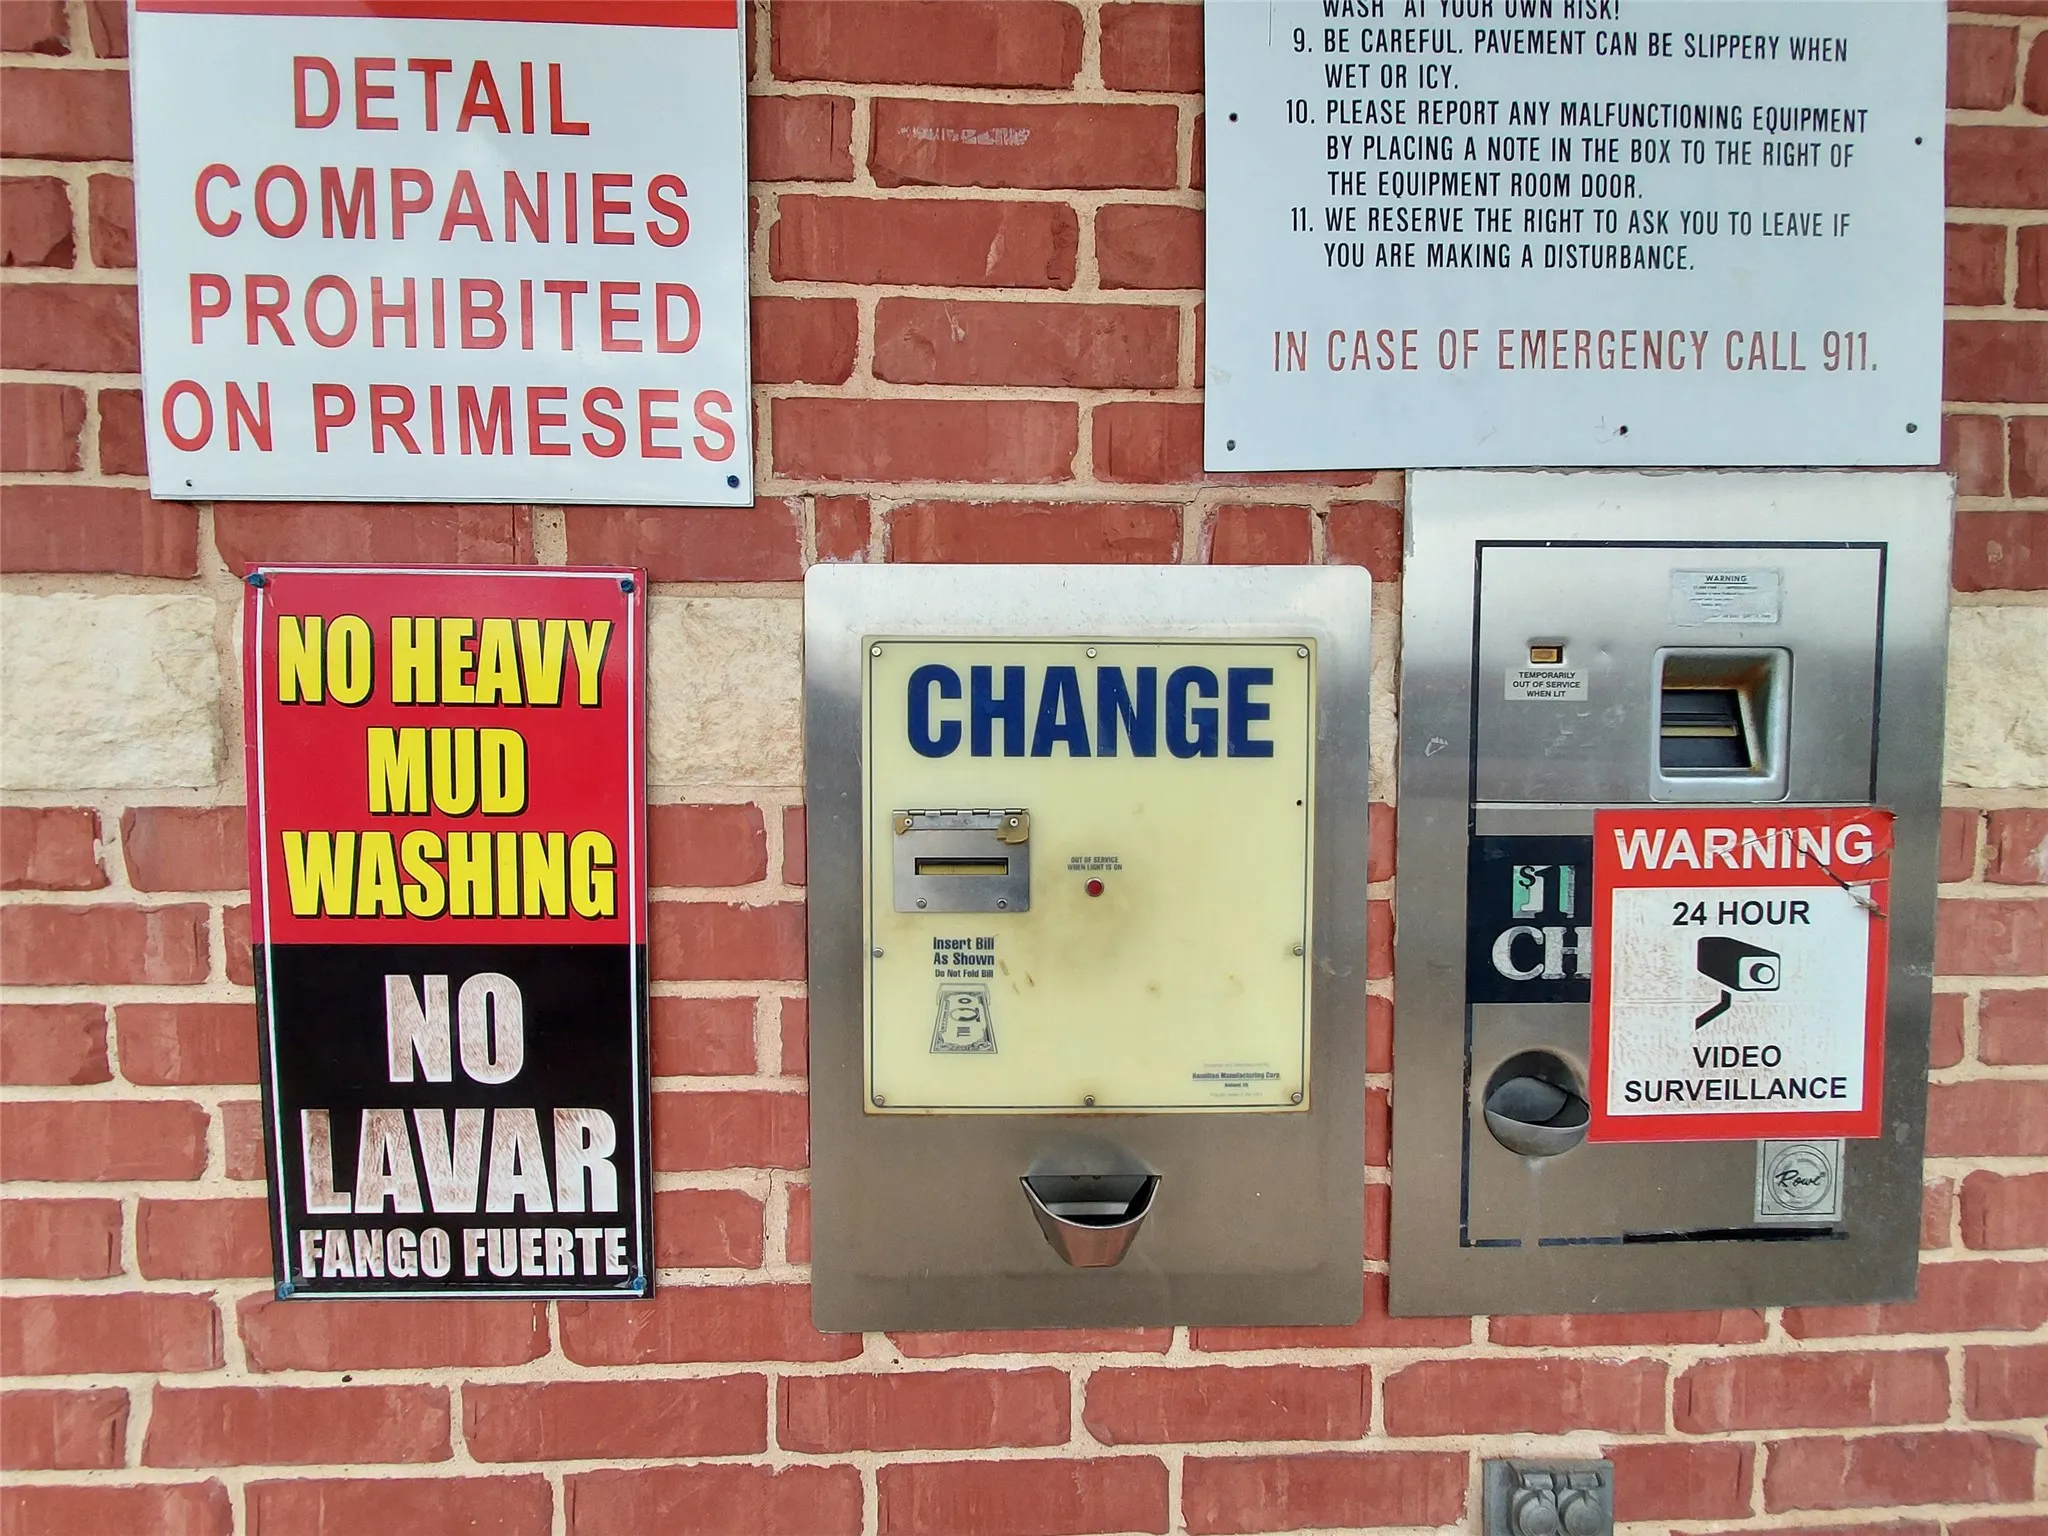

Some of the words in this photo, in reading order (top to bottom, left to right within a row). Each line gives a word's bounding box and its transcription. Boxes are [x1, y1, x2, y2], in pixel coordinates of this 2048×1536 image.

[1322, 0, 1384, 18] WASH
[1404, 0, 1425, 18] AT
[1440, 0, 1493, 18] YOUR
[1505, 0, 1552, 19] OWN
[1564, 0, 1619, 21] RISK!
[1293, 27, 1312, 53] 9.
[1324, 28, 1350, 53] BE
[1361, 28, 1463, 54] CAREFUL.
[1474, 29, 1587, 55] PAVEMENT
[1596, 30, 1637, 56] CAN
[1648, 32, 1673, 57] BE
[1684, 32, 1780, 60] SLIPPERY
[1789, 36, 1847, 62] WHEN
[1324, 63, 1371, 89] WET
[1380, 63, 1407, 89] OR
[1419, 63, 1458, 90] ICY.
[293, 56, 590, 136] DETAIL
[1286, 99, 1315, 124] 10.
[1327, 99, 1407, 125] PLEASE
[1418, 99, 1500, 125] REPORT
[1508, 100, 1550, 126] ANY
[1560, 101, 1742, 130] MALFUNCTIONING
[1753, 106, 1868, 135] EQUIPMENT
[1327, 135, 1353, 160] BY
[1363, 135, 1453, 161] PLACING
[1463, 136, 1477, 161] A
[1487, 136, 1540, 162] NOTE
[1551, 137, 1572, 162] IN
[1581, 137, 1619, 163] THE
[1630, 138, 1671, 164] BOX
[1680, 139, 1705, 165] TO
[1714, 140, 1752, 166] THE
[1763, 141, 1822, 167] RIGHT
[1830, 143, 1854, 168] OF
[1327, 170, 1367, 196] THE
[1378, 170, 1501, 199] EQUIPMENT
[1510, 172, 1570, 198] ROOM
[1581, 173, 1643, 199] DOOR.
[193, 162, 690, 247] COMPANIES
[1291, 206, 1314, 232] 11.
[1324, 206, 1357, 232] WE
[1368, 206, 1464, 233] RESERVE
[1474, 207, 1513, 233] THE
[1524, 208, 1585, 234] RIGHT
[1592, 209, 1617, 234] TO
[1628, 209, 1669, 235] ASK
[1680, 210, 1718, 236] YOU
[1727, 211, 1752, 236] TO
[1762, 211, 1823, 237] LEAVE
[1833, 213, 1851, 237] IF
[1323, 242, 1364, 268] YOU
[1375, 242, 1416, 268] ARE
[1427, 243, 1511, 269] MAKING
[1520, 243, 1534, 269] A
[1544, 243, 1694, 271] DISTURBANCE.
[188, 273, 701, 353] PROHIBITED
[1274, 330, 1307, 372] IN
[1327, 328, 1418, 372] CASE
[1438, 328, 1479, 371] OF
[1498, 329, 1709, 371] EMERGENCY
[1726, 330, 1807, 371] CALL
[1823, 330, 1877, 372] 911.
[161, 379, 273, 452] ON
[313, 383, 735, 462] PRIMESES
[277, 614, 374, 706] NO
[391, 615, 615, 708] HEAVY
[1518, 671, 1576, 679] TEMPORARILY
[1512, 680, 1530, 688] OUT
[1545, 681, 1581, 689] SERVICE
[1553, 690, 1566, 698] LIT
[906, 663, 1275, 759] CHANGE
[366, 725, 528, 817] MUD
[1613, 824, 1874, 870] WARNING
[281, 828, 619, 921] WASHING
[1067, 863, 1086, 871] WHEN
[1087, 863, 1104, 871] LIGHT
[1105, 863, 1112, 871] IS
[1113, 863, 1123, 871] ON
[1672, 901, 1708, 926] 24
[1718, 900, 1811, 926] HOUR
[933, 936, 972, 950] Insert
[975, 936, 995, 950] Bill
[933, 952, 949, 965] As
[952, 952, 995, 966] Shown
[935, 968, 945, 978] Do
[947, 968, 961, 978] Not
[963, 969, 980, 978] Fold
[981, 969, 994, 978] Bill
[384, 972, 524, 1085] NO
[1692, 1044, 1782, 1069] VIDEO
[1624, 1076, 1847, 1103] SURVEILLANCE
[300, 1107, 619, 1215] LAVAR
[299, 1227, 451, 1278] FANGO
[462, 1227, 629, 1277] FUERTE
